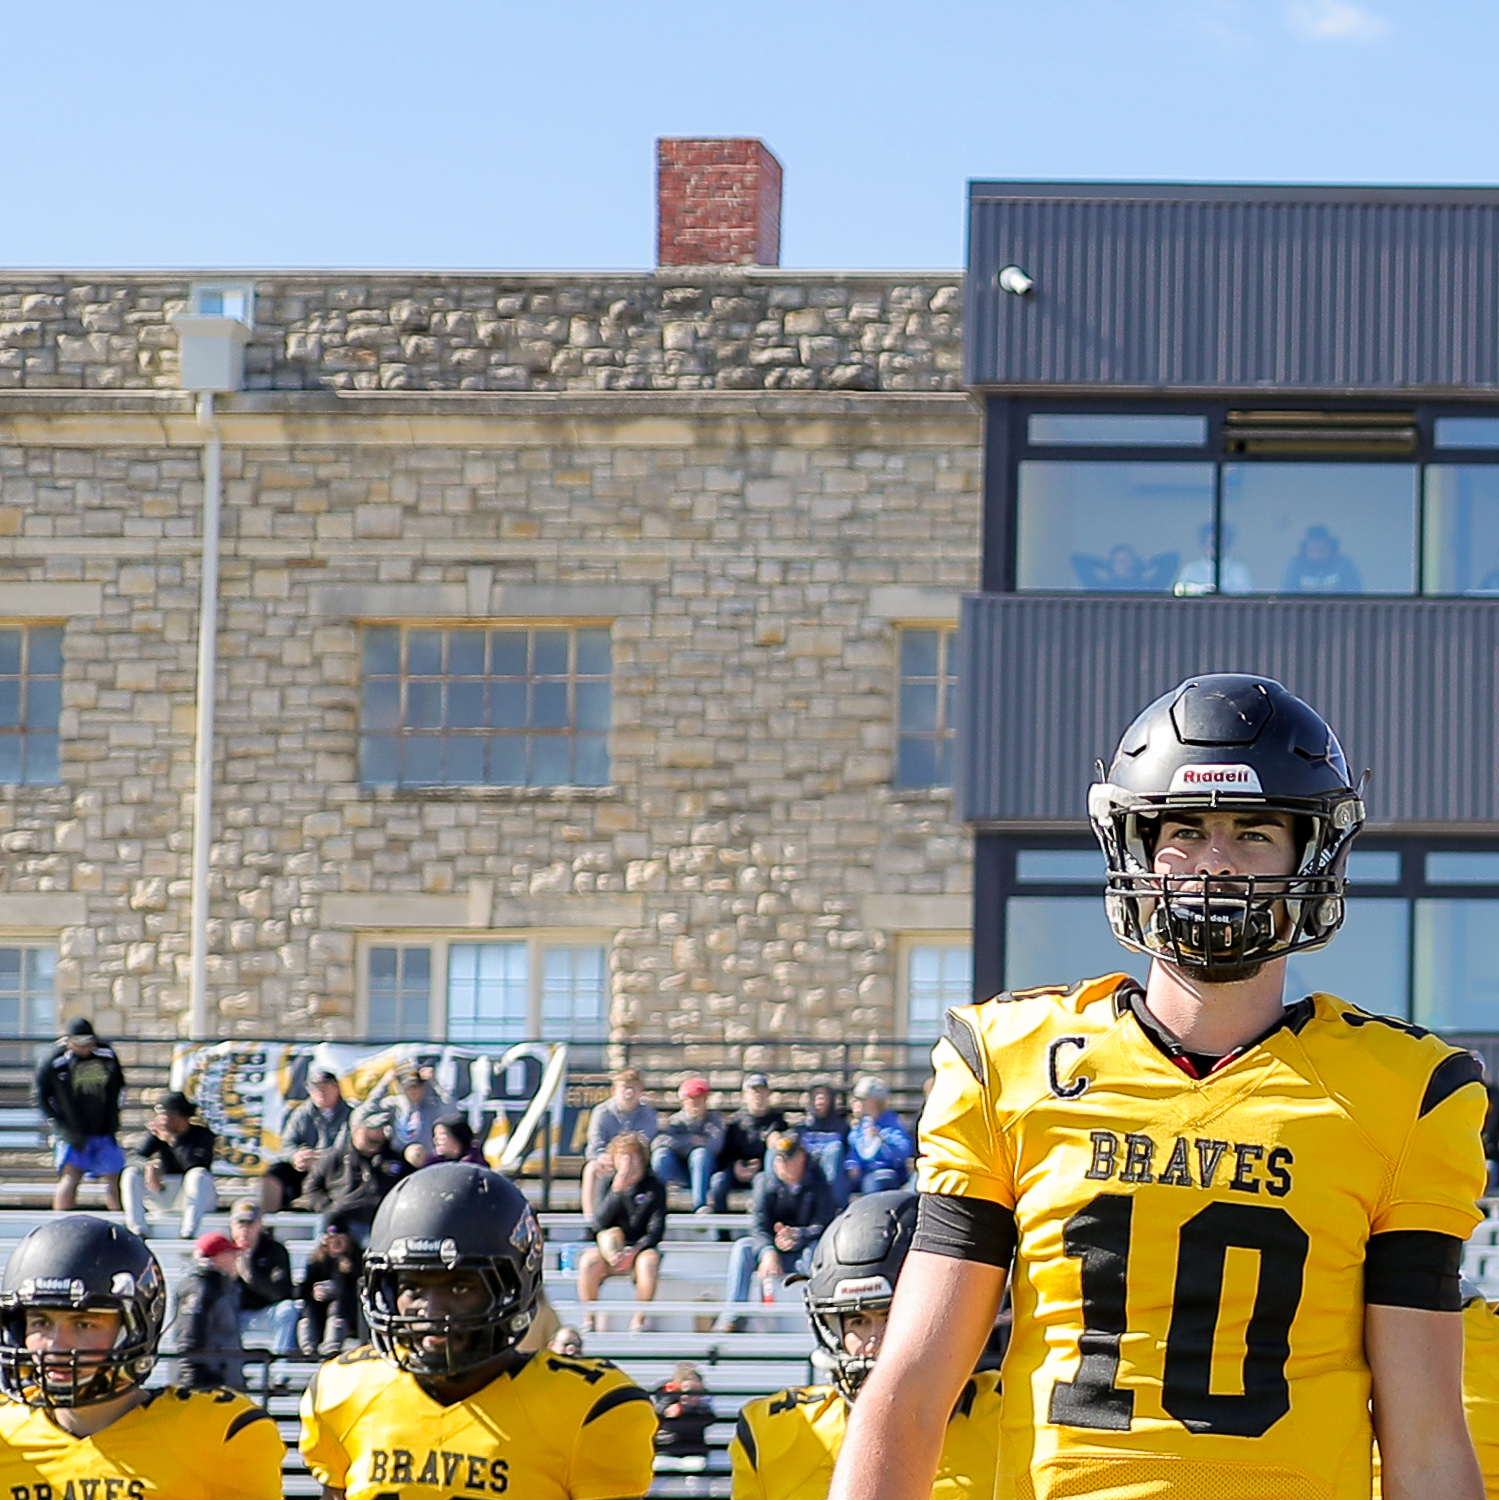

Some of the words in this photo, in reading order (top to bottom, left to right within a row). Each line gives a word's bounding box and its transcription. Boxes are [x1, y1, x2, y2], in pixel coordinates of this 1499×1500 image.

[1183, 769, 1249, 784] Riddell
[1048, 1036, 1090, 1100] C
[1088, 1131, 1294, 1197] BRAVES
[1050, 1193, 1310, 1438] 10
[370, 1450, 509, 1493] BRAVES
